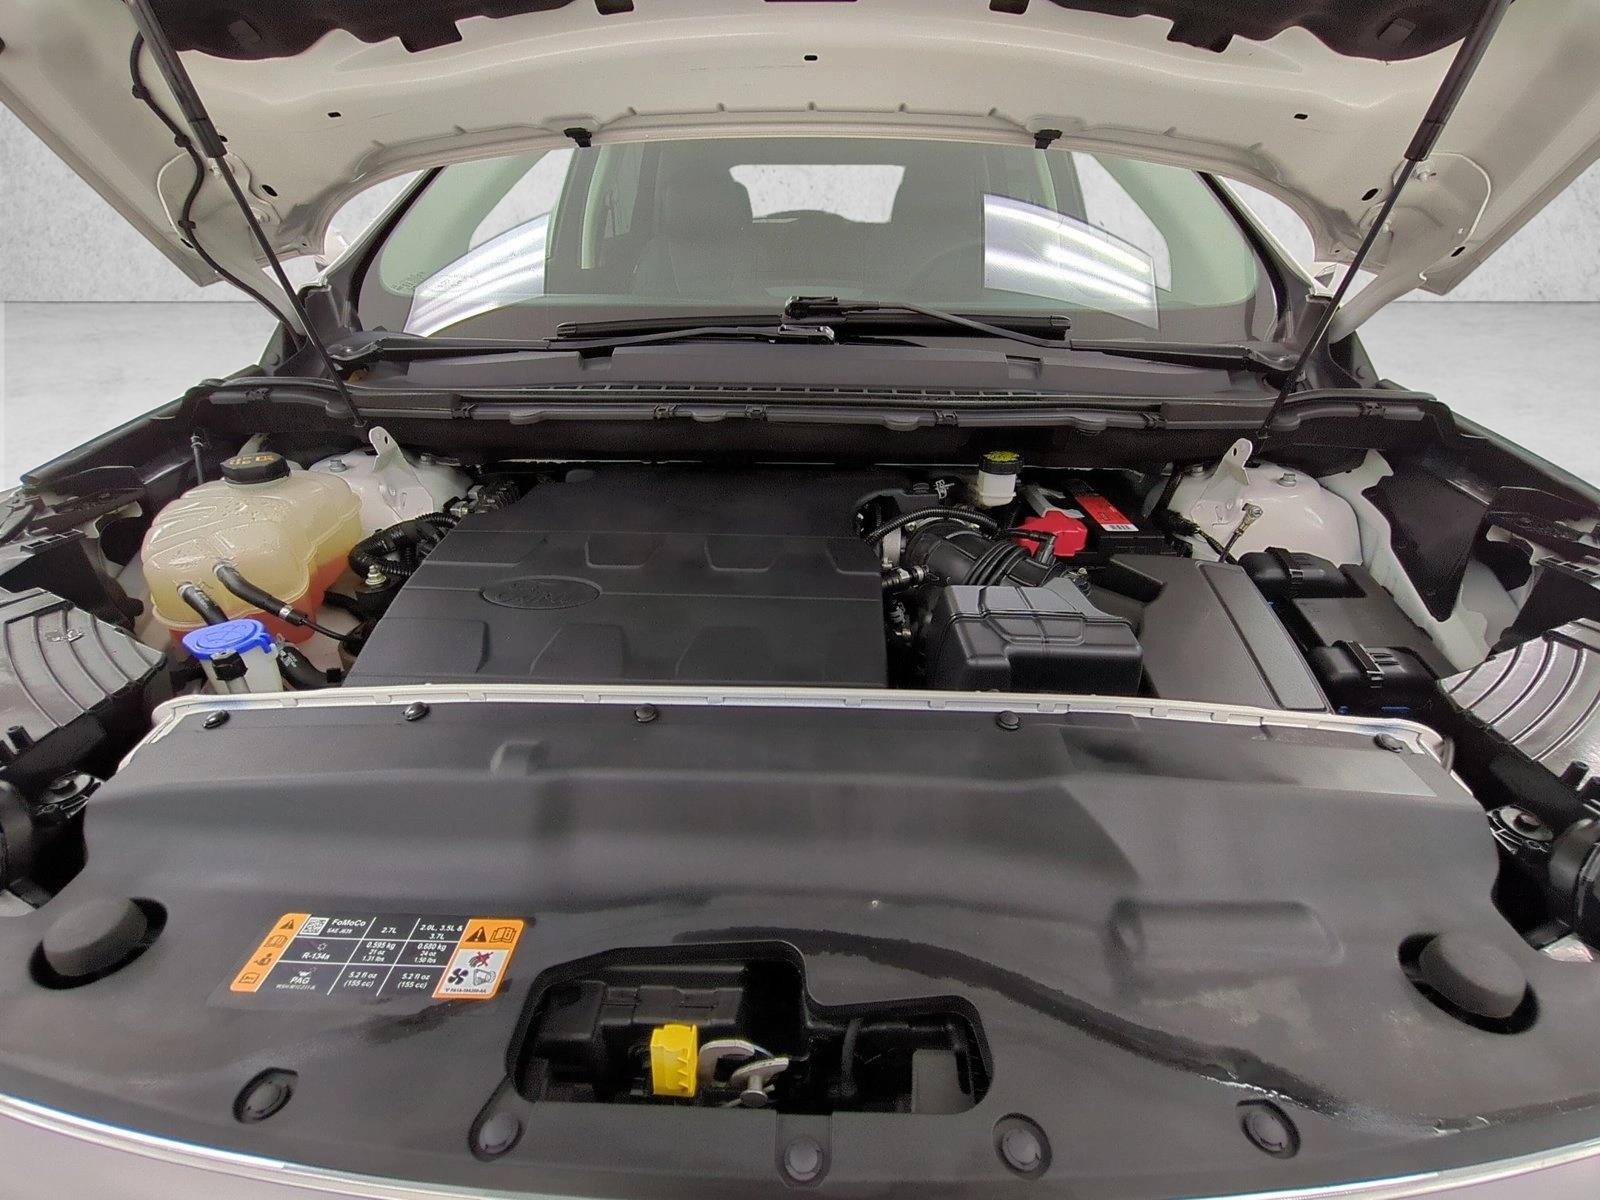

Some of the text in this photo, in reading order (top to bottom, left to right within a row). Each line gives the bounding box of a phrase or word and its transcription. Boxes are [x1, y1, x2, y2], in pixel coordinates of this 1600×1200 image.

[331, 918, 367, 927] FoMoCo
[366, 941, 396, 951] 0.595 kg
[436, 943, 447, 952] kg
[301, 951, 331, 960] R-134a
[348, 971, 361, 979] 5.2
[290, 976, 311, 984] PAG
